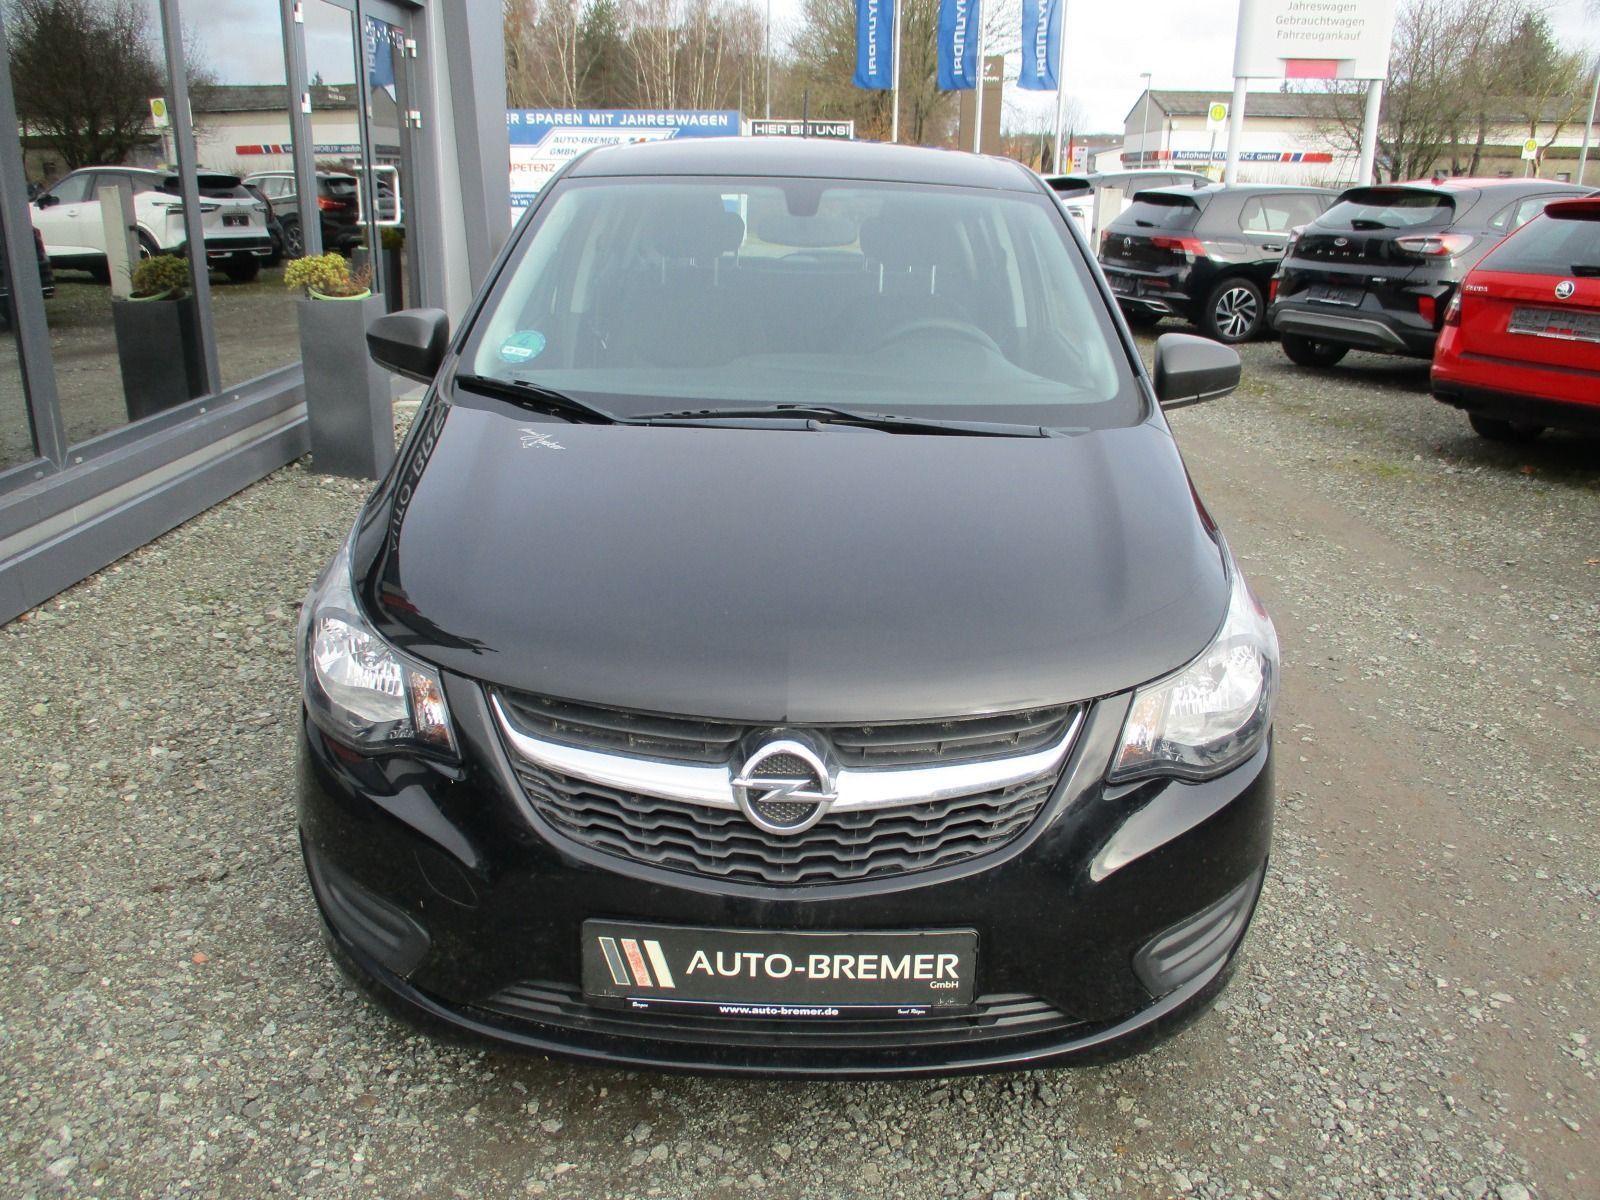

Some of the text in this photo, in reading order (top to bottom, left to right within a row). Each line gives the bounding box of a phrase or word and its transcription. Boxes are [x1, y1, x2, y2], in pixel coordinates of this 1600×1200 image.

[1288, 1, 1357, 13] Jahreswagen
[1275, 16, 1365, 28] Gebrauchtwagen
[1276, 30, 1362, 41] Fahrzeugankauf
[526, 113, 582, 125] SPAREN
[589, 113, 614, 125] MIT
[620, 114, 728, 126] JAHRESWAGEN
[754, 124, 787, 134] HIER
[553, 136, 620, 145] AUTO-BREMER
[549, 148, 578, 156] GMBH
[1256, 153, 1277, 161] GmbH
[686, 950, 959, 979] AUTO-BREMER
[929, 981, 959, 989] GmbH
[719, 1005, 839, 1016] www.auto-bremer.de
